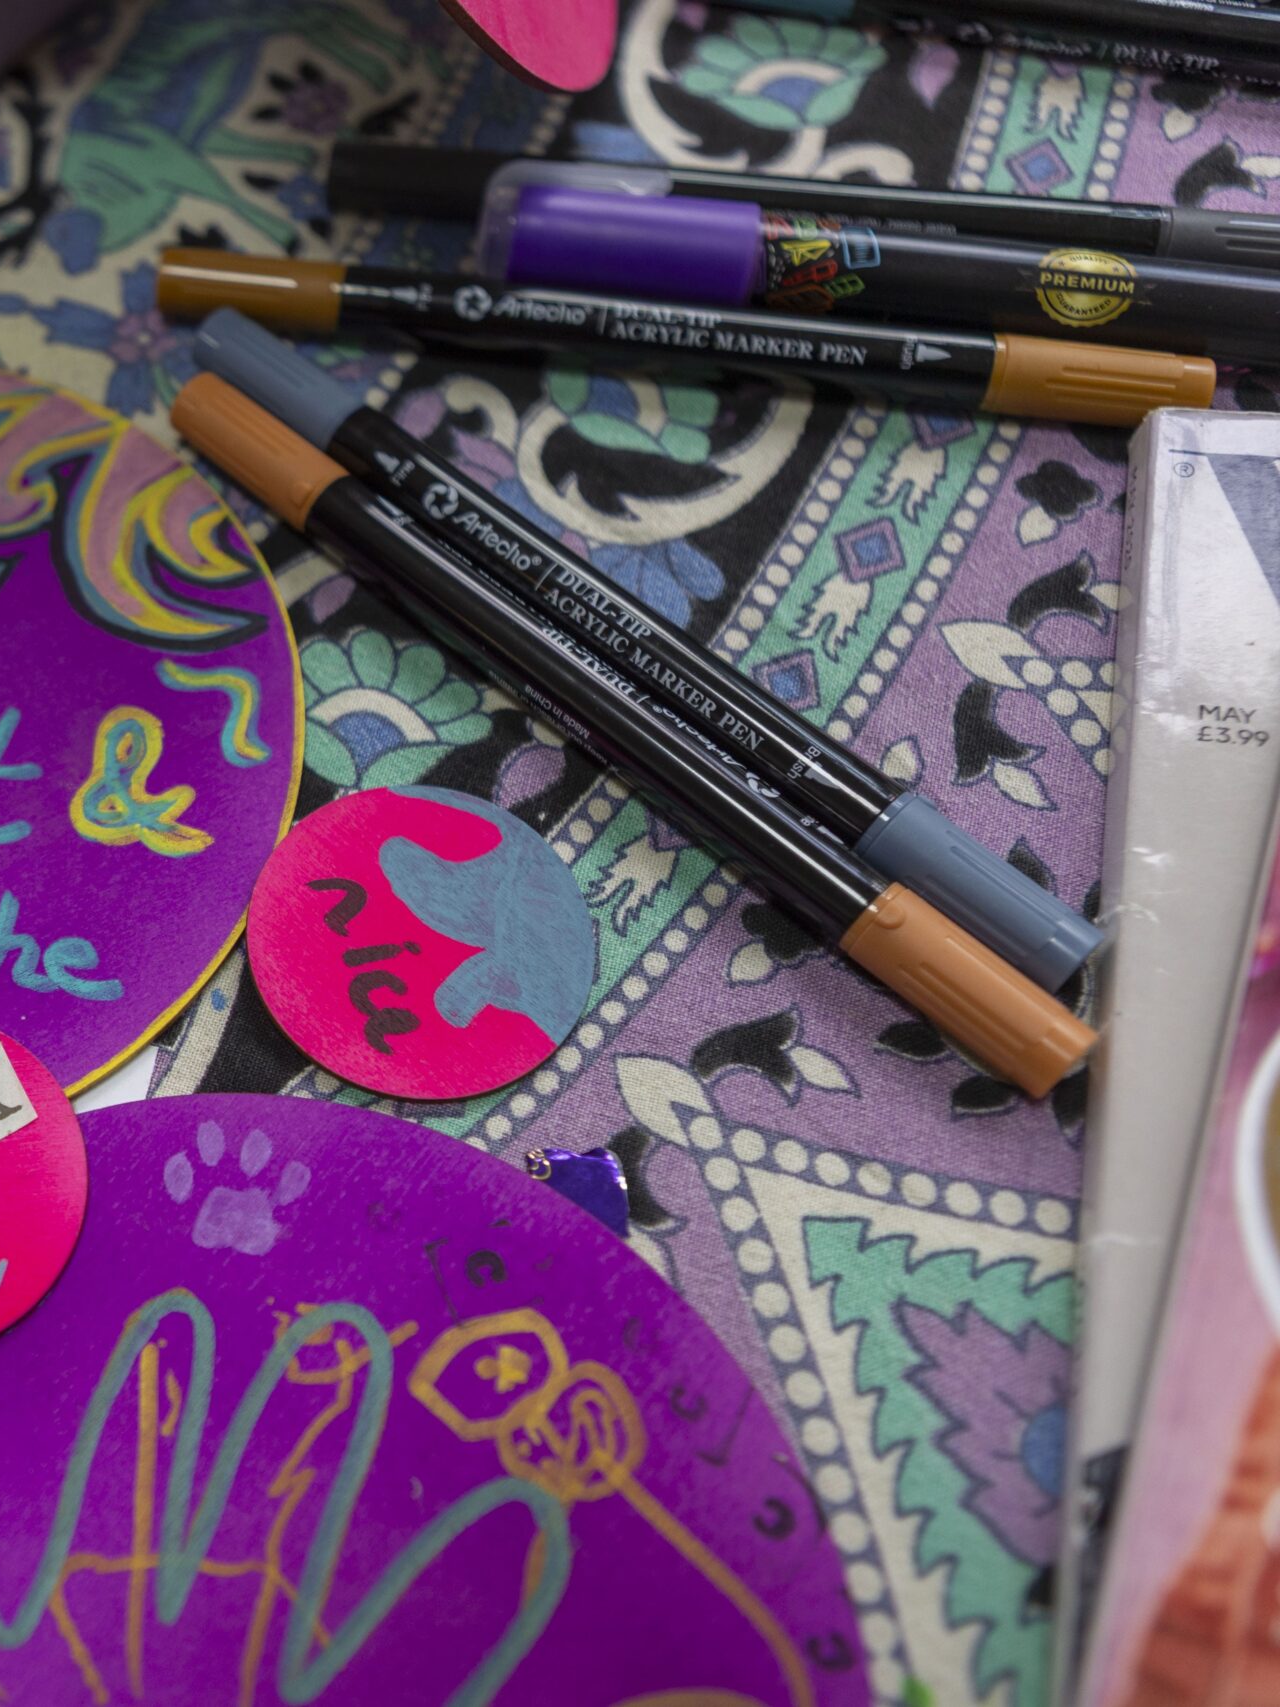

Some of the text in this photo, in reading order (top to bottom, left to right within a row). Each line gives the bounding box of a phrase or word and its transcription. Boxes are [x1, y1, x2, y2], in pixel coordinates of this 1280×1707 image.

[1040, 271, 1135, 294] PREMIUM
[611, 321, 867, 366] ACRYLIC MARKER PEN
[556, 567, 653, 640] DUAL-TIP
[544, 588, 767, 752] ACRYLIC MARKER PEN
[524, 684, 552, 711] China
[563, 713, 591, 740] Made
[1197, 704, 1257, 724] MAY
[1197, 726, 1270, 748] £3.99
[69, 705, 216, 858] &
